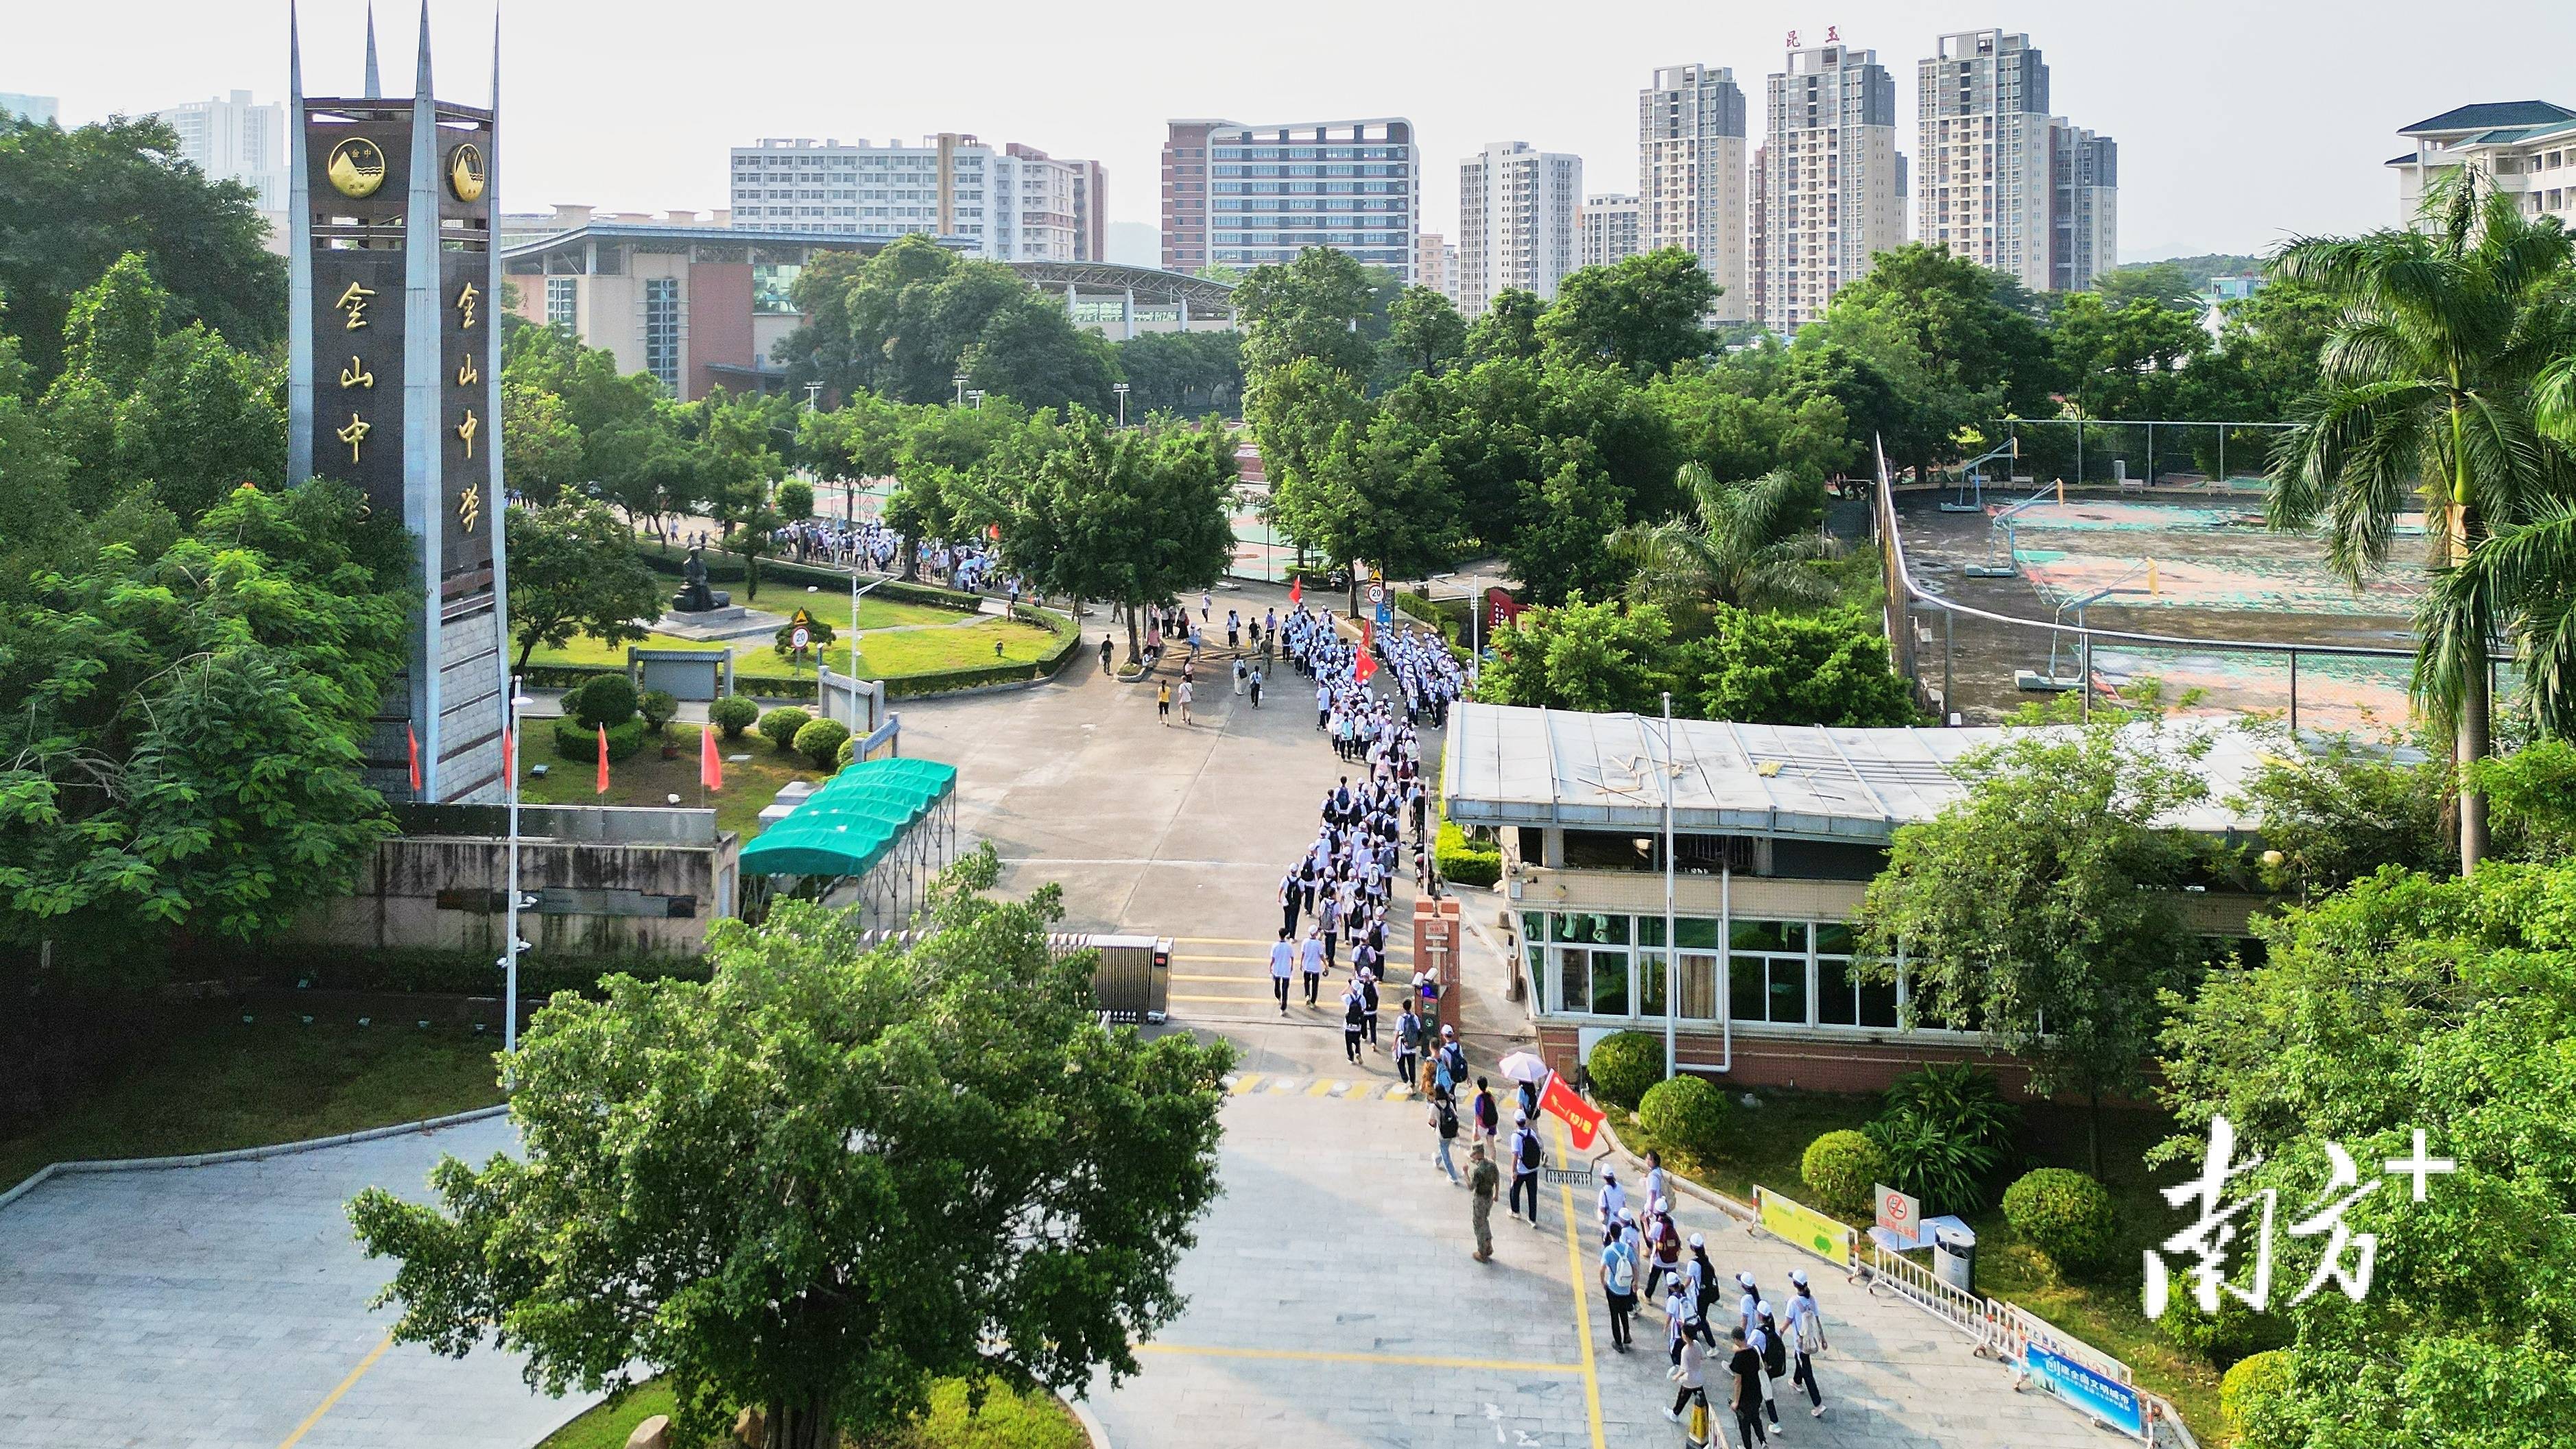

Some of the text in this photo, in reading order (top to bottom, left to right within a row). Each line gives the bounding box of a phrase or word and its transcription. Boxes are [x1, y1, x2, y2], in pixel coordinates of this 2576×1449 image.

[1787, 25, 1840, 47] 昆玉
[457, 281, 480, 533] 金山中学
[1372, 589, 1381, 597] 20
[796, 632, 805, 642] 20
